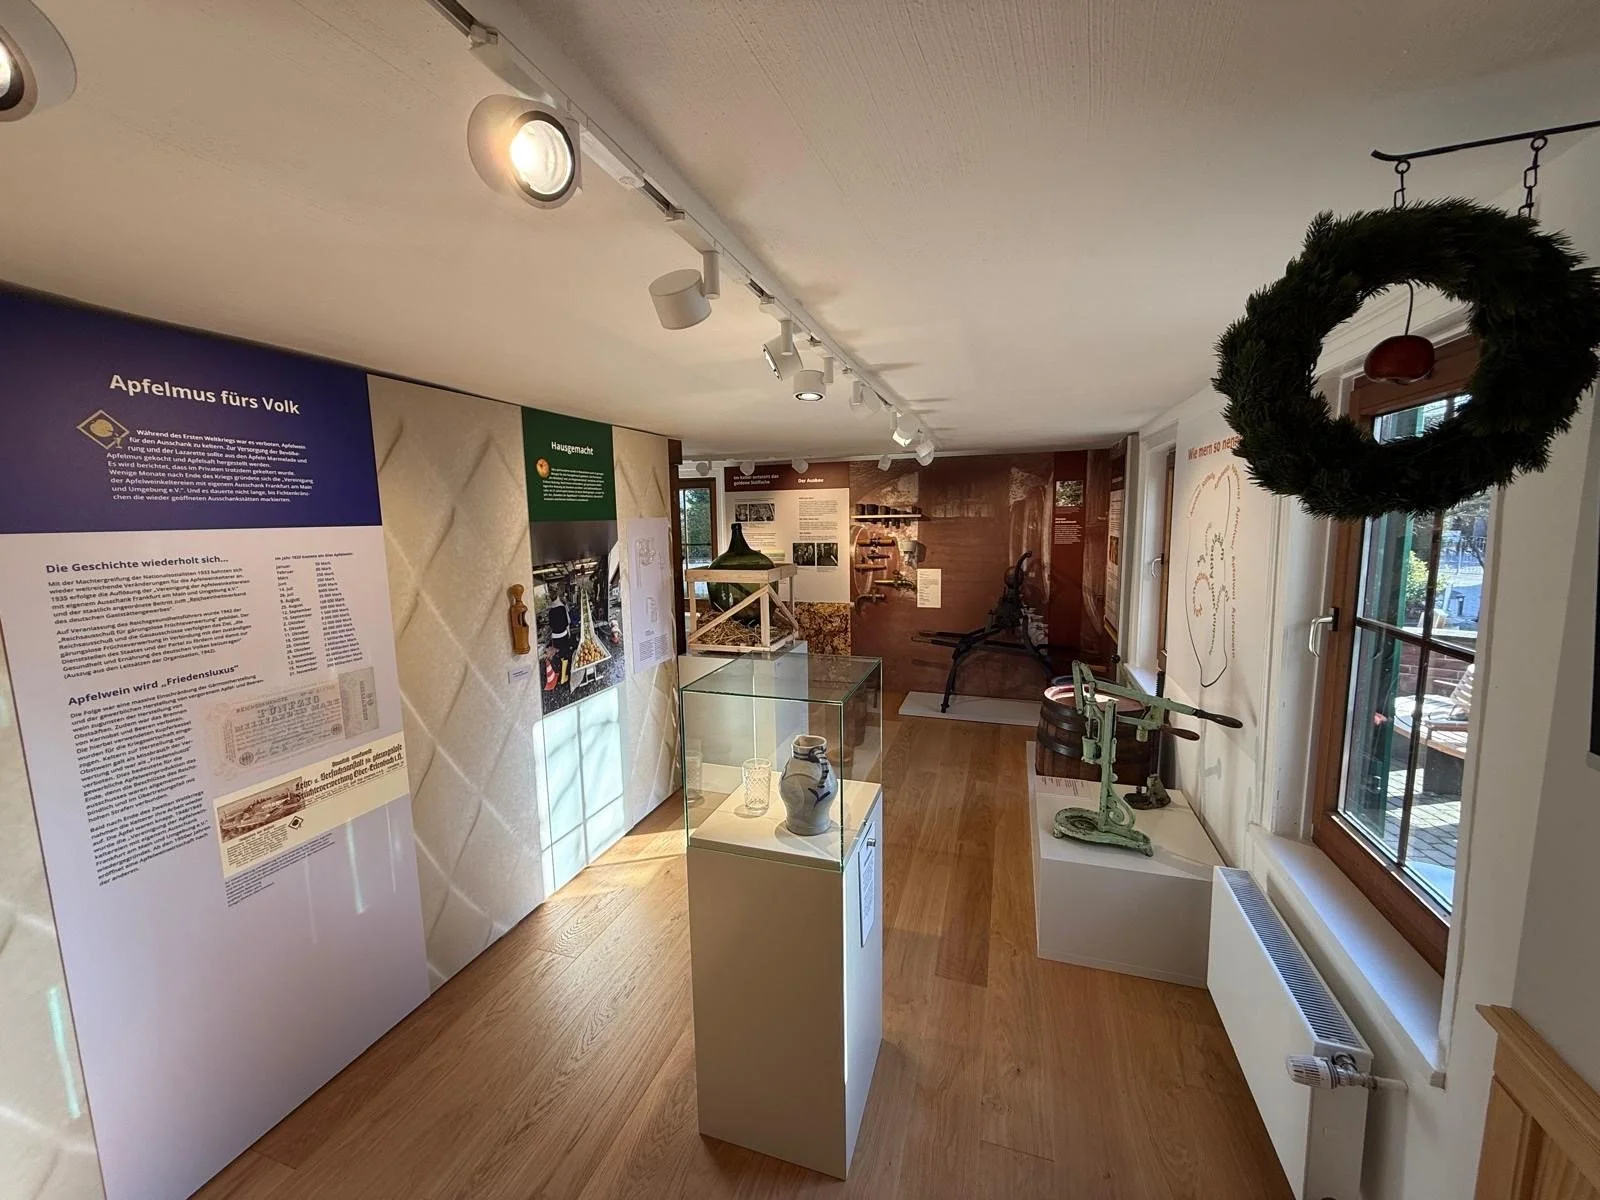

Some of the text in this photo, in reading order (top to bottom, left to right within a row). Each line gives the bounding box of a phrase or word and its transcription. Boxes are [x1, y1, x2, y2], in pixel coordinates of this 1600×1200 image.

[110, 374, 300, 414] Apfelmus fürs Volk
[136, 429, 168, 438] Während
[156, 438, 191, 447] Ausschank
[552, 441, 593, 455] Hausgemacht
[106, 452, 142, 461] Apfelmus
[109, 468, 136, 478] Wenige
[128, 485, 167, 495] Umgebung
[46, 564, 68, 573] Die
[71, 560, 139, 572] Geschichte
[142, 556, 198, 568] wiederholt
[68, 665, 239, 706] Apfelwein wird „Friedensluxus“
